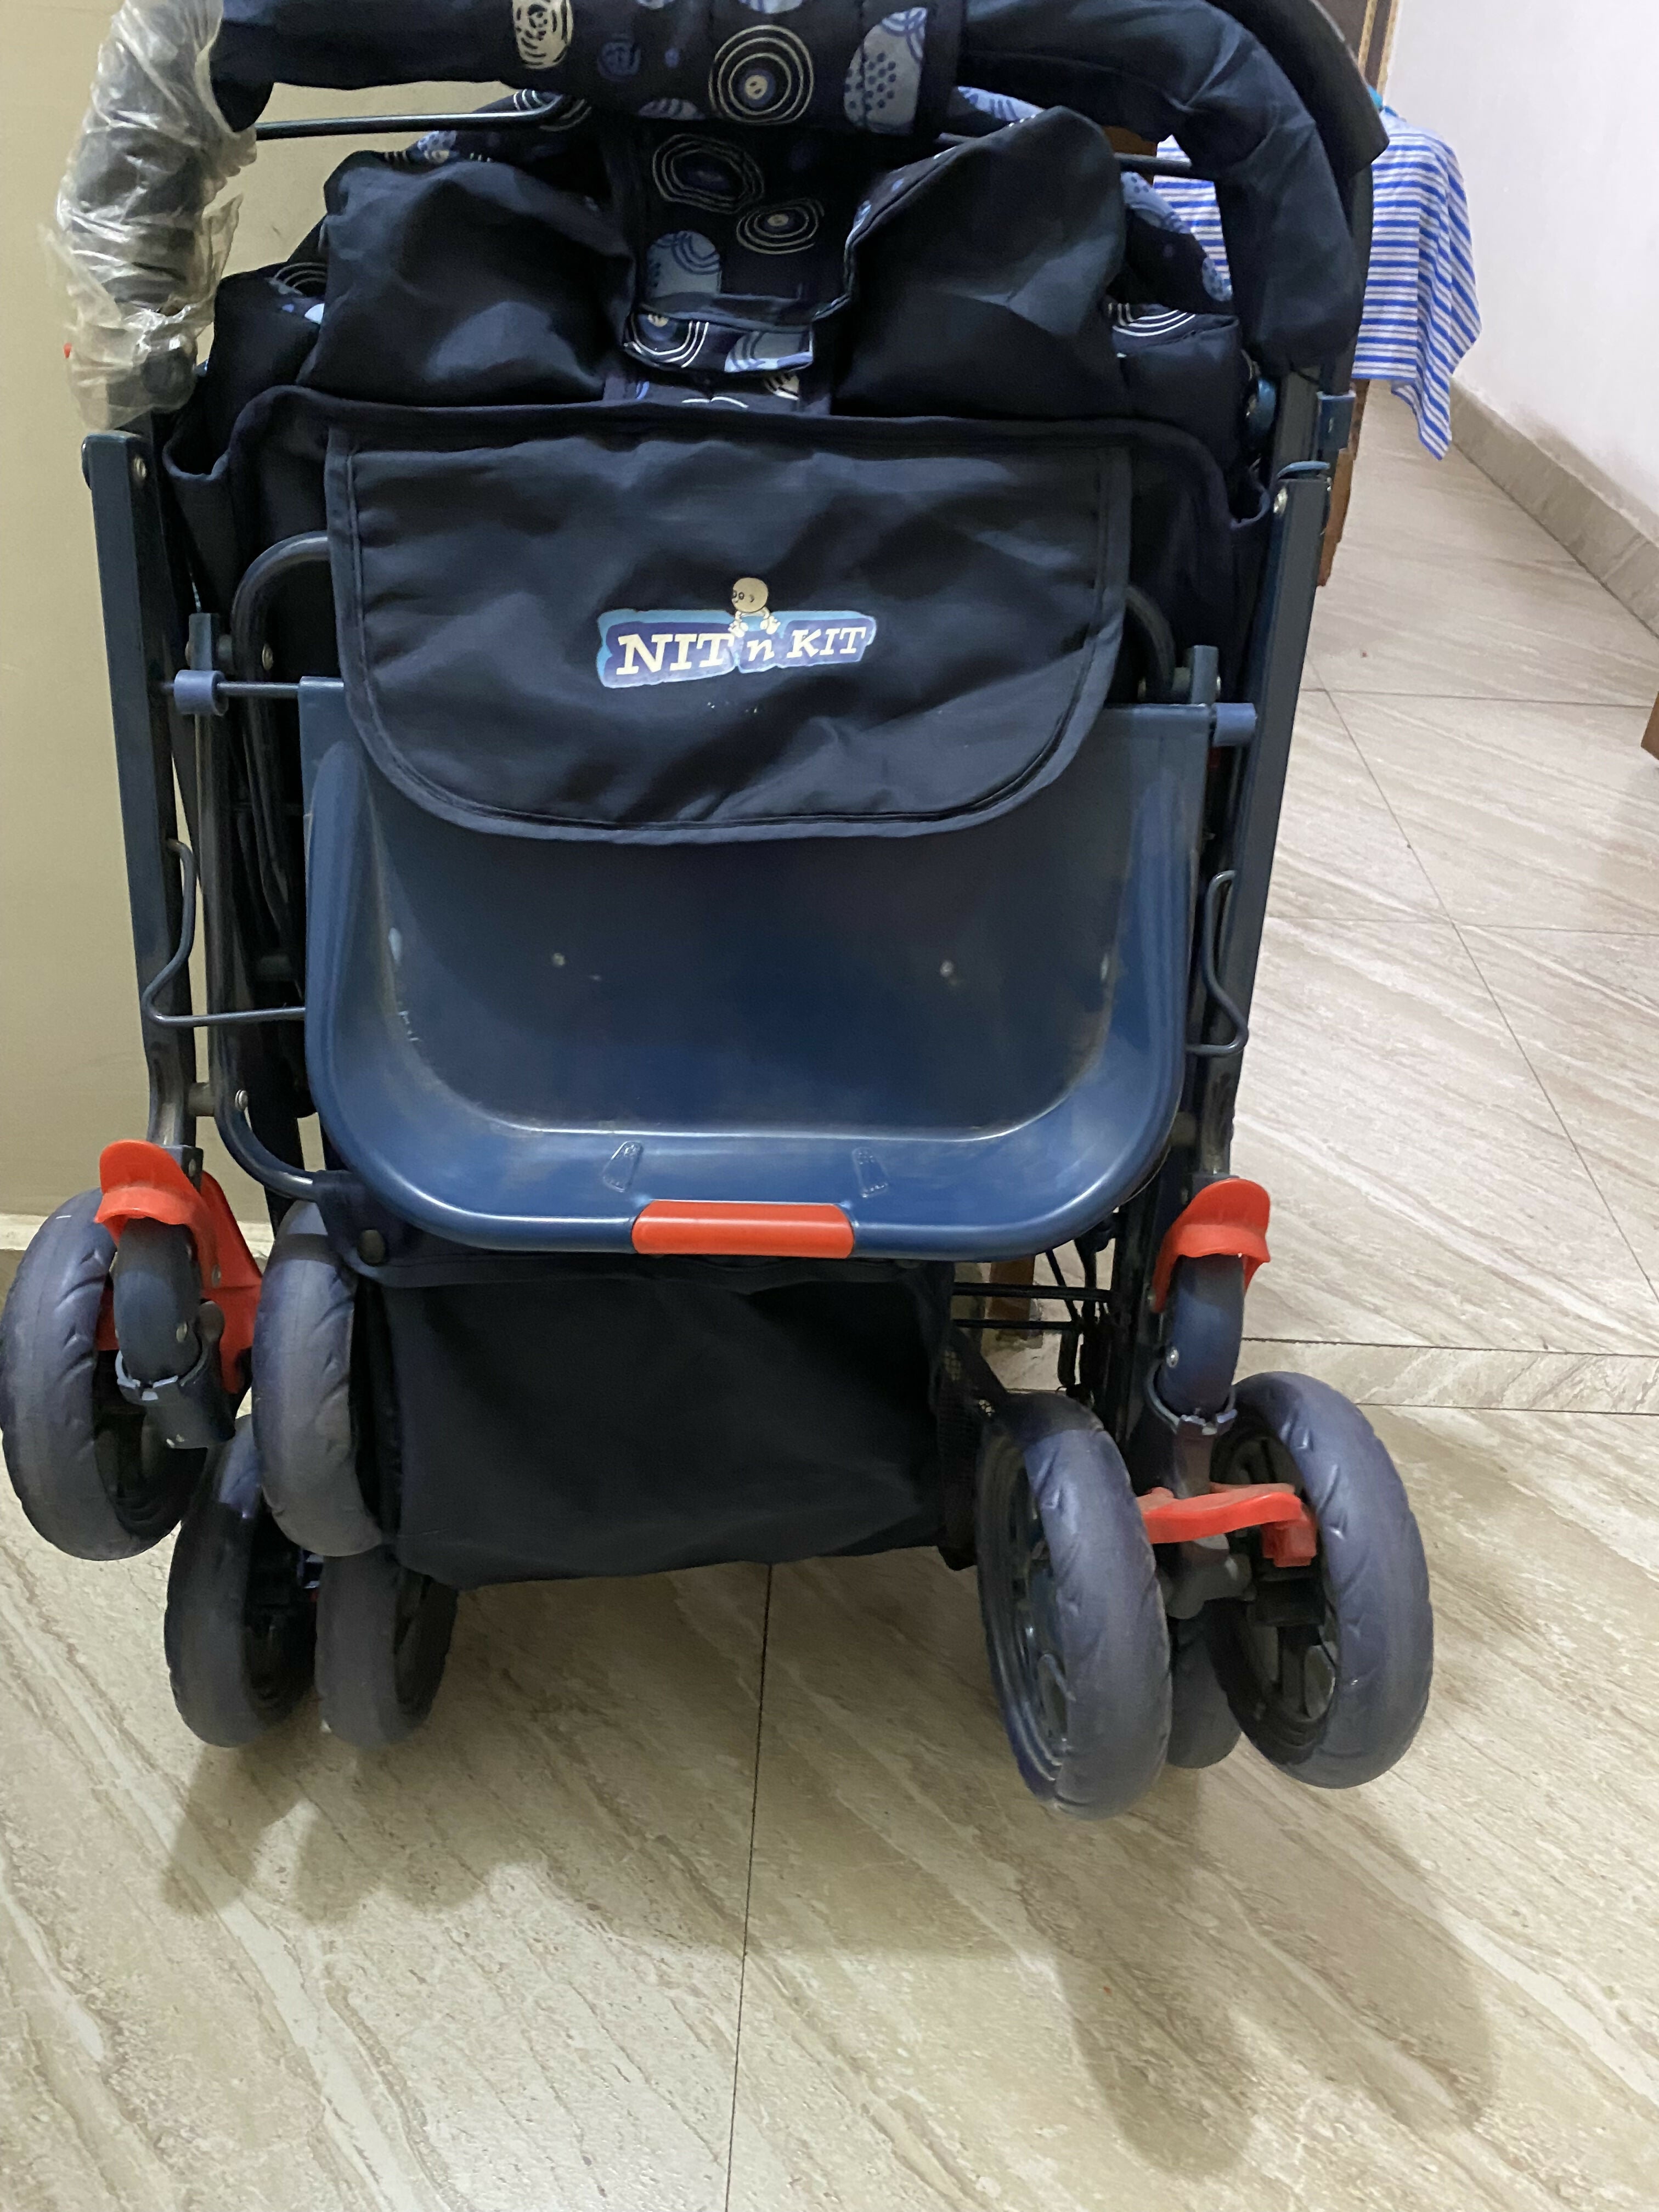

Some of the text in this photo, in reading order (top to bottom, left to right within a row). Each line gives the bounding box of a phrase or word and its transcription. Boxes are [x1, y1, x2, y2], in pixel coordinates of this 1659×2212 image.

[616, 627, 866, 675] NIT n KIT
